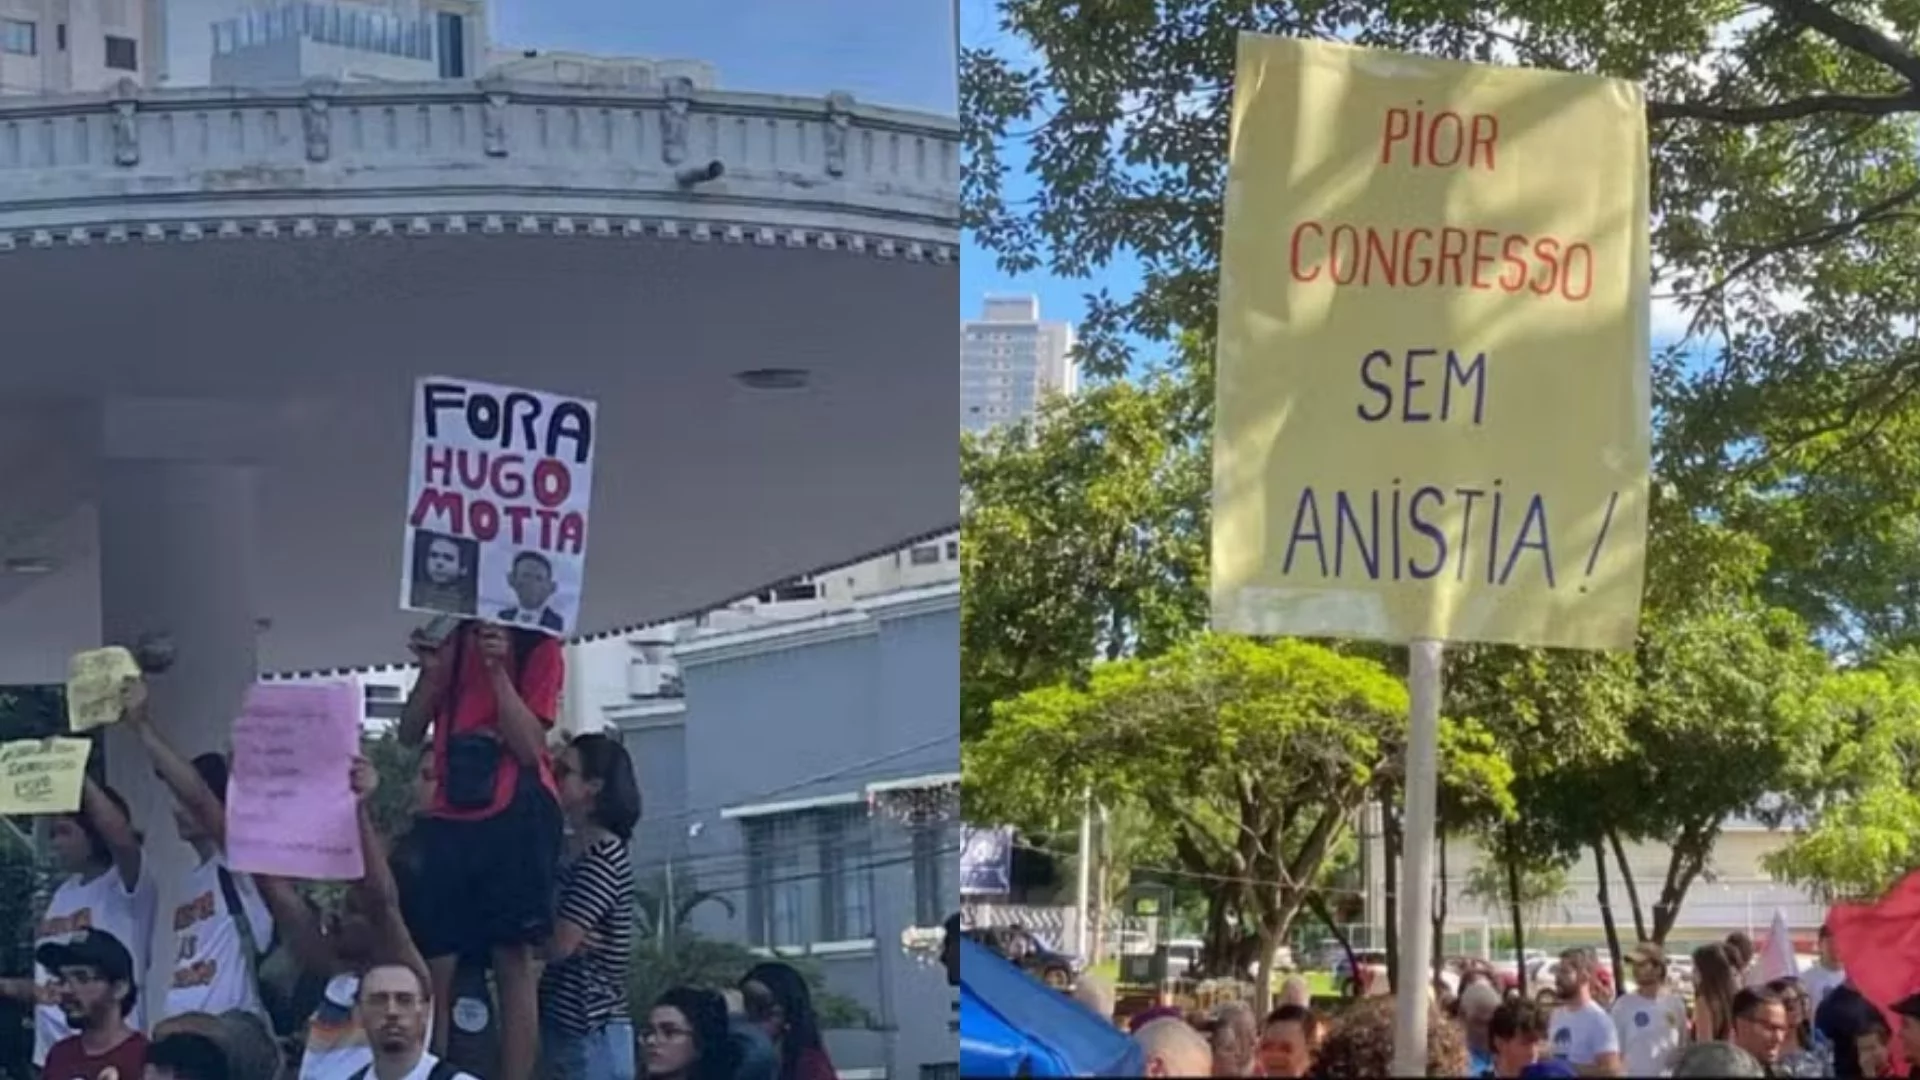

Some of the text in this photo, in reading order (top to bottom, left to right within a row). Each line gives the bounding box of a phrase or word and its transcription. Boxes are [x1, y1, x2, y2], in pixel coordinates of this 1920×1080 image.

[1290, 221, 1595, 302] CONGRESSO
[423, 383, 592, 463] FORA
[1356, 349, 1487, 425] SEM
[425, 445, 572, 507] HUGO
[410, 488, 585, 555] MOTTA
